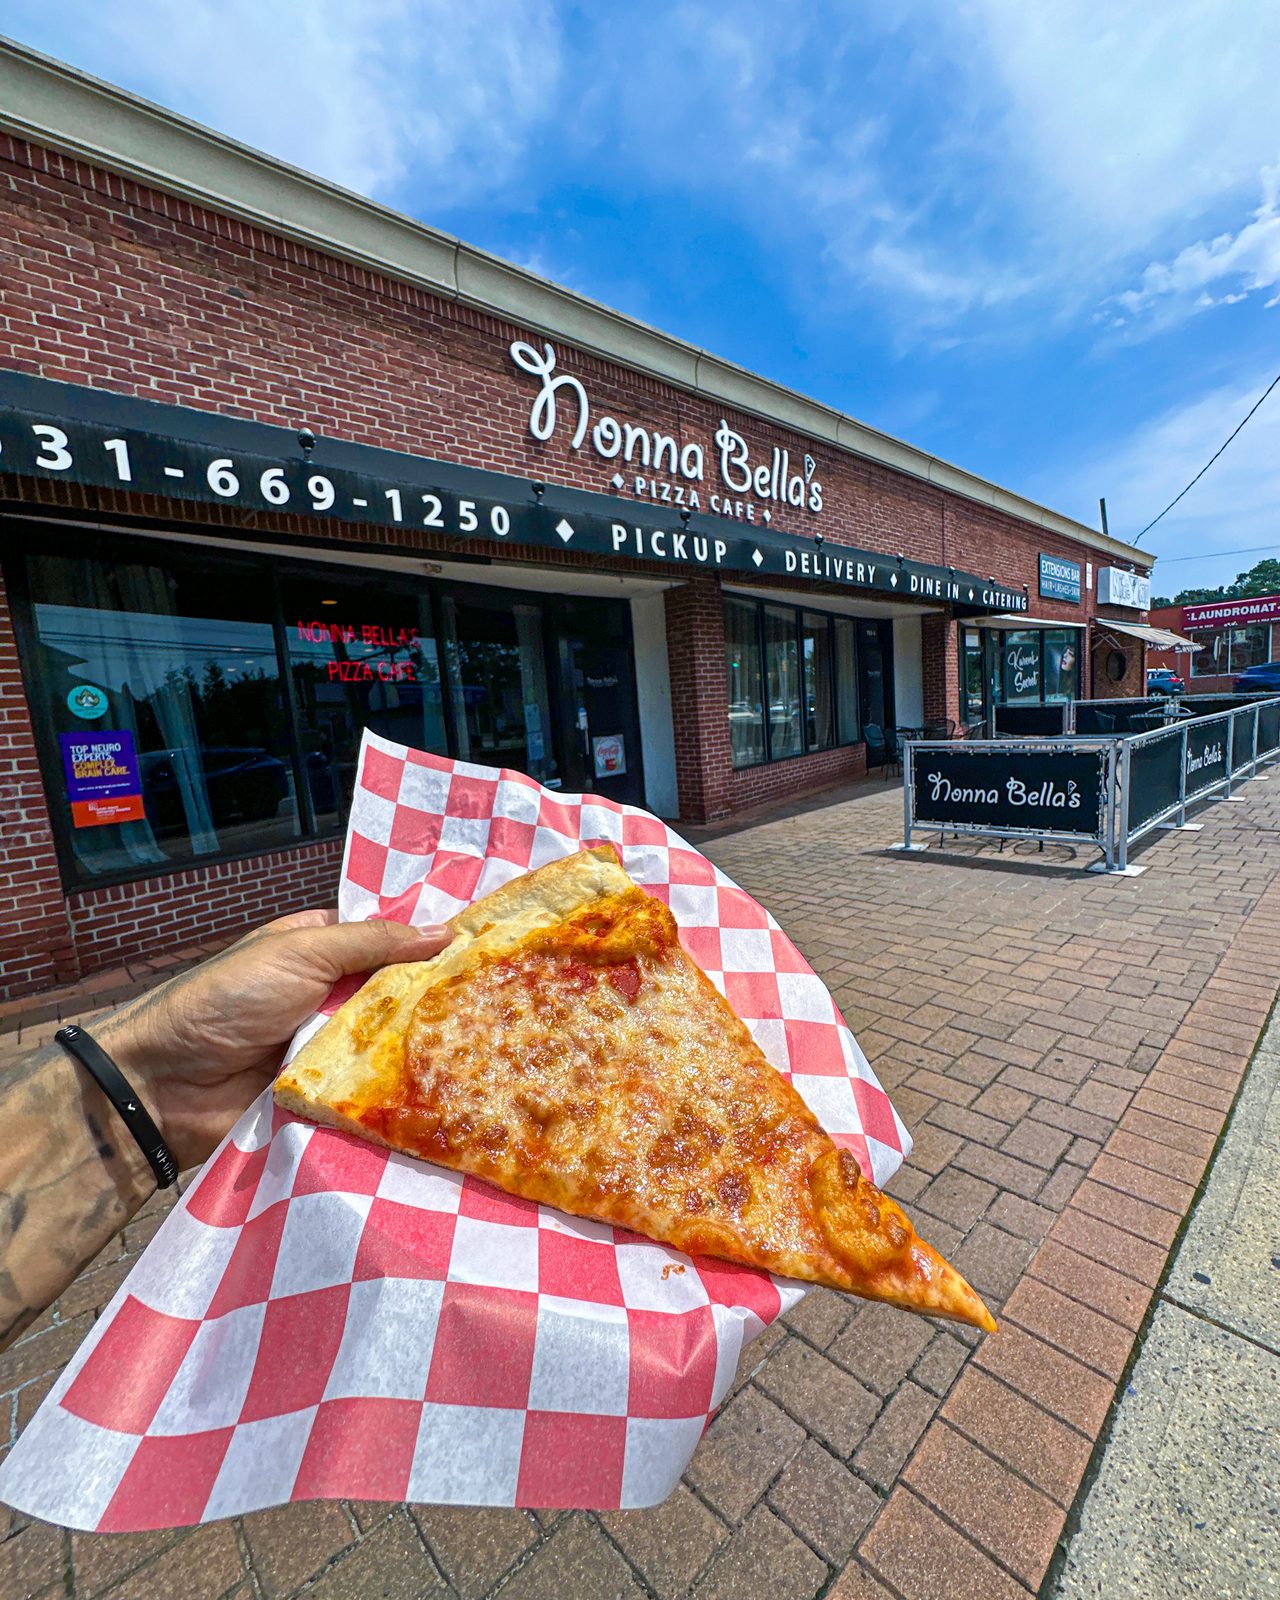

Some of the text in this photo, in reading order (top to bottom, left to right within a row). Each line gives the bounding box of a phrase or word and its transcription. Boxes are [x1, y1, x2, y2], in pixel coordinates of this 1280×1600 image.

[510, 341, 823, 513] Nonna Bella's
[0, 424, 511, 536] 31-669-1250
[635, 476, 756, 521] PIZZA CAFE
[611, 524, 1028, 611] PICKUP DELIVERY DINE IN CATERING
[1191, 603, 1277, 621] LAUNDROMAT
[297, 621, 356, 643] NONNA
[328, 661, 416, 681] PIZZA CAFE
[70, 743, 121, 755] TOP NEURO
[927, 772, 1081, 808] Nonna Bella's
